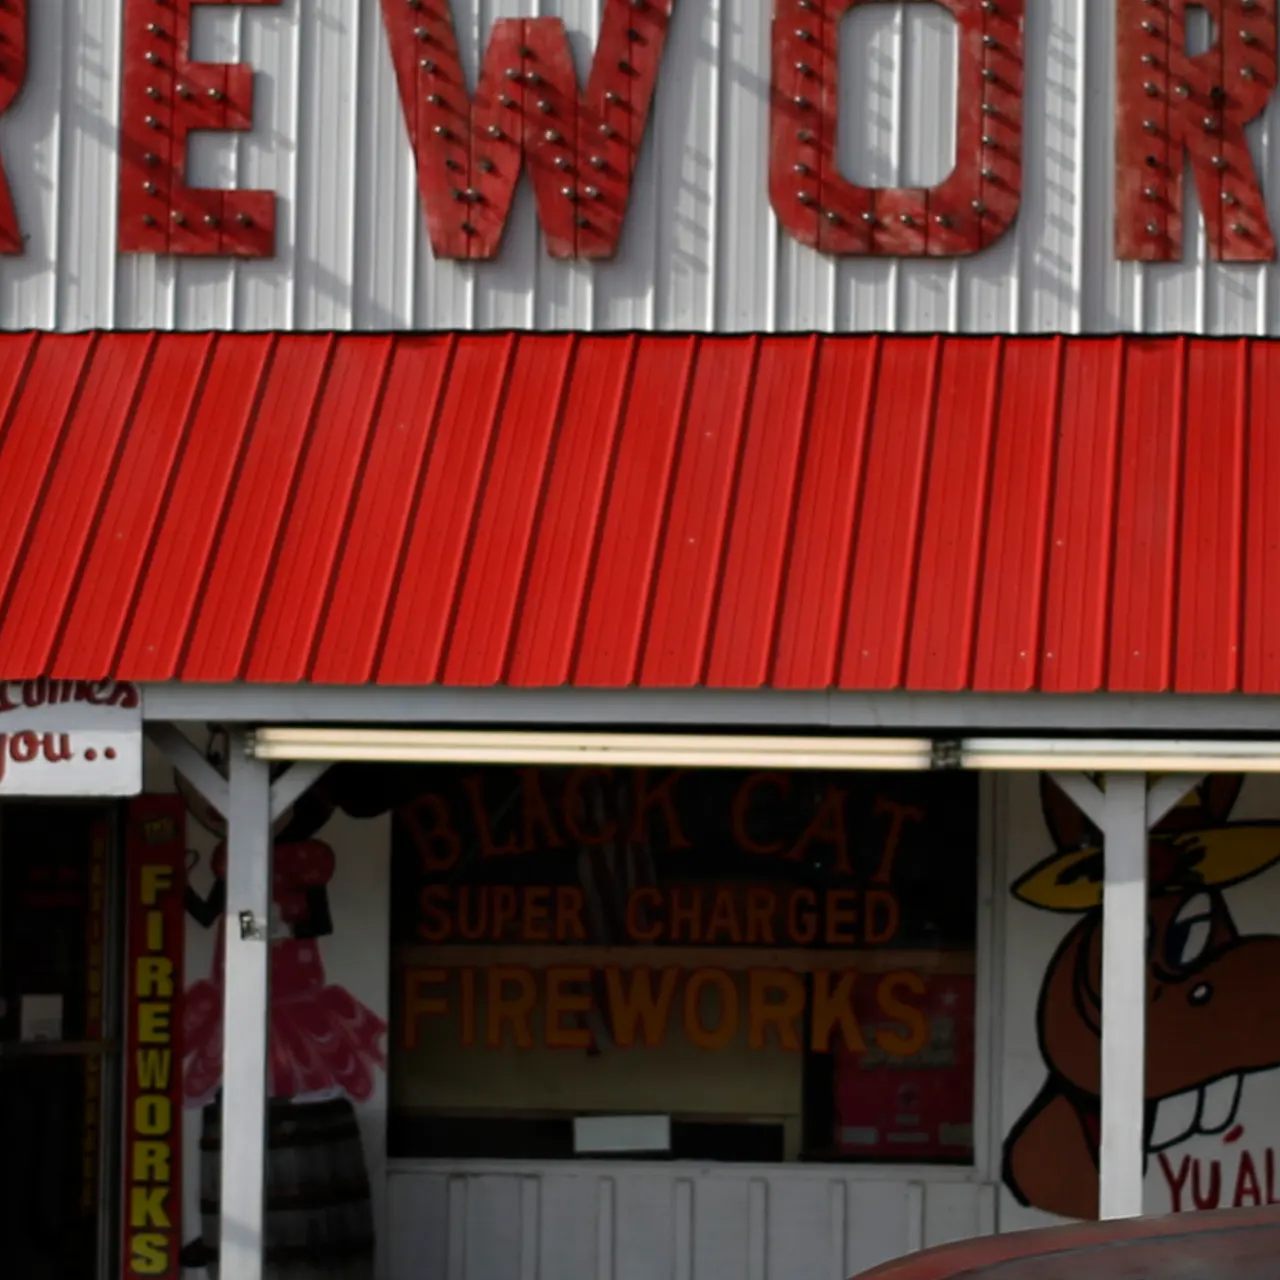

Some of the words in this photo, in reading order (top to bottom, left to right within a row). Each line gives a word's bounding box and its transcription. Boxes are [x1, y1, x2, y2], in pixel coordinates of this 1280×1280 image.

[404, 766, 694, 875] BLACK
[729, 770, 928, 884] CAT
[417, 882, 586, 943] SUPER
[625, 885, 902, 946] CHARGED
[399, 963, 932, 1056] FIREWORKS
[129, 863, 174, 1275] FIREWORKS
